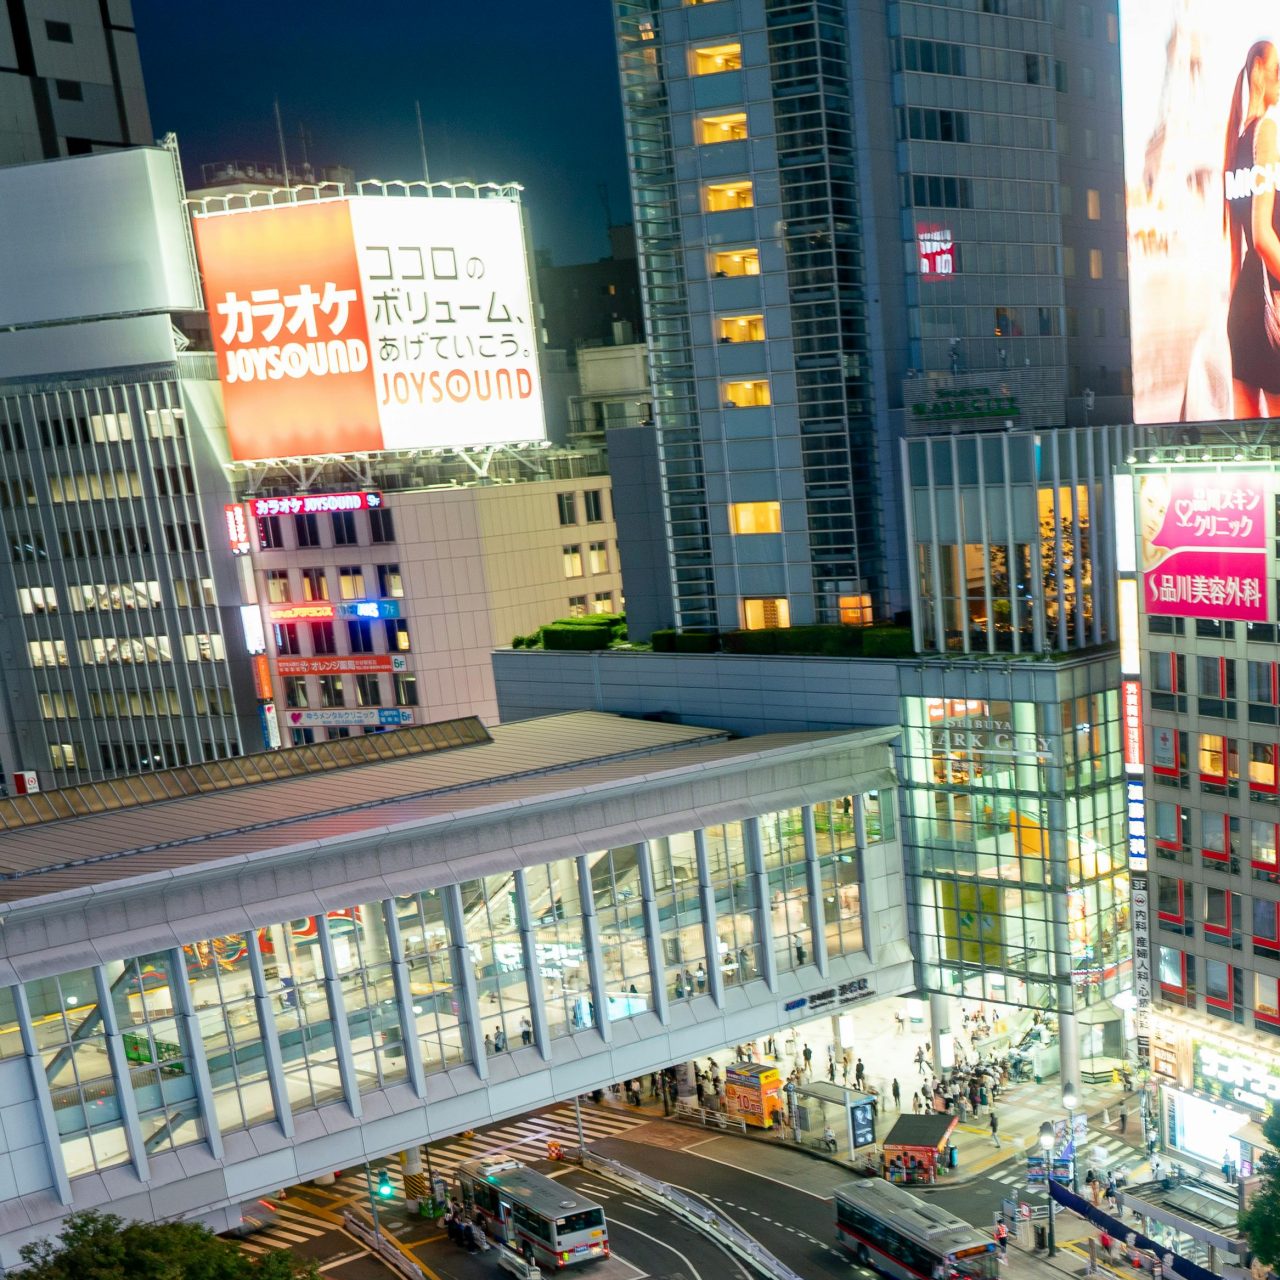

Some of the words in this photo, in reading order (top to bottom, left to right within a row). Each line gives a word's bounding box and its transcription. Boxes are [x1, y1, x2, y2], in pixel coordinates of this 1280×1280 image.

[366, 246, 486, 282] ココロの
[217, 281, 357, 346] カラオケ
[372, 287, 525, 326] ボリューム、
[226, 339, 369, 384] JOYSOUND
[378, 331, 531, 363] あげていこう。
[382, 367, 533, 405] JOYSOUND
[255, 498, 303, 514] カラオケ
[303, 495, 362, 512] JOYSOUND
[1192, 487, 1260, 512] 品川スキン
[1193, 514, 1254, 538] クリニック
[1160, 573, 1263, 608] 品川美容外科
